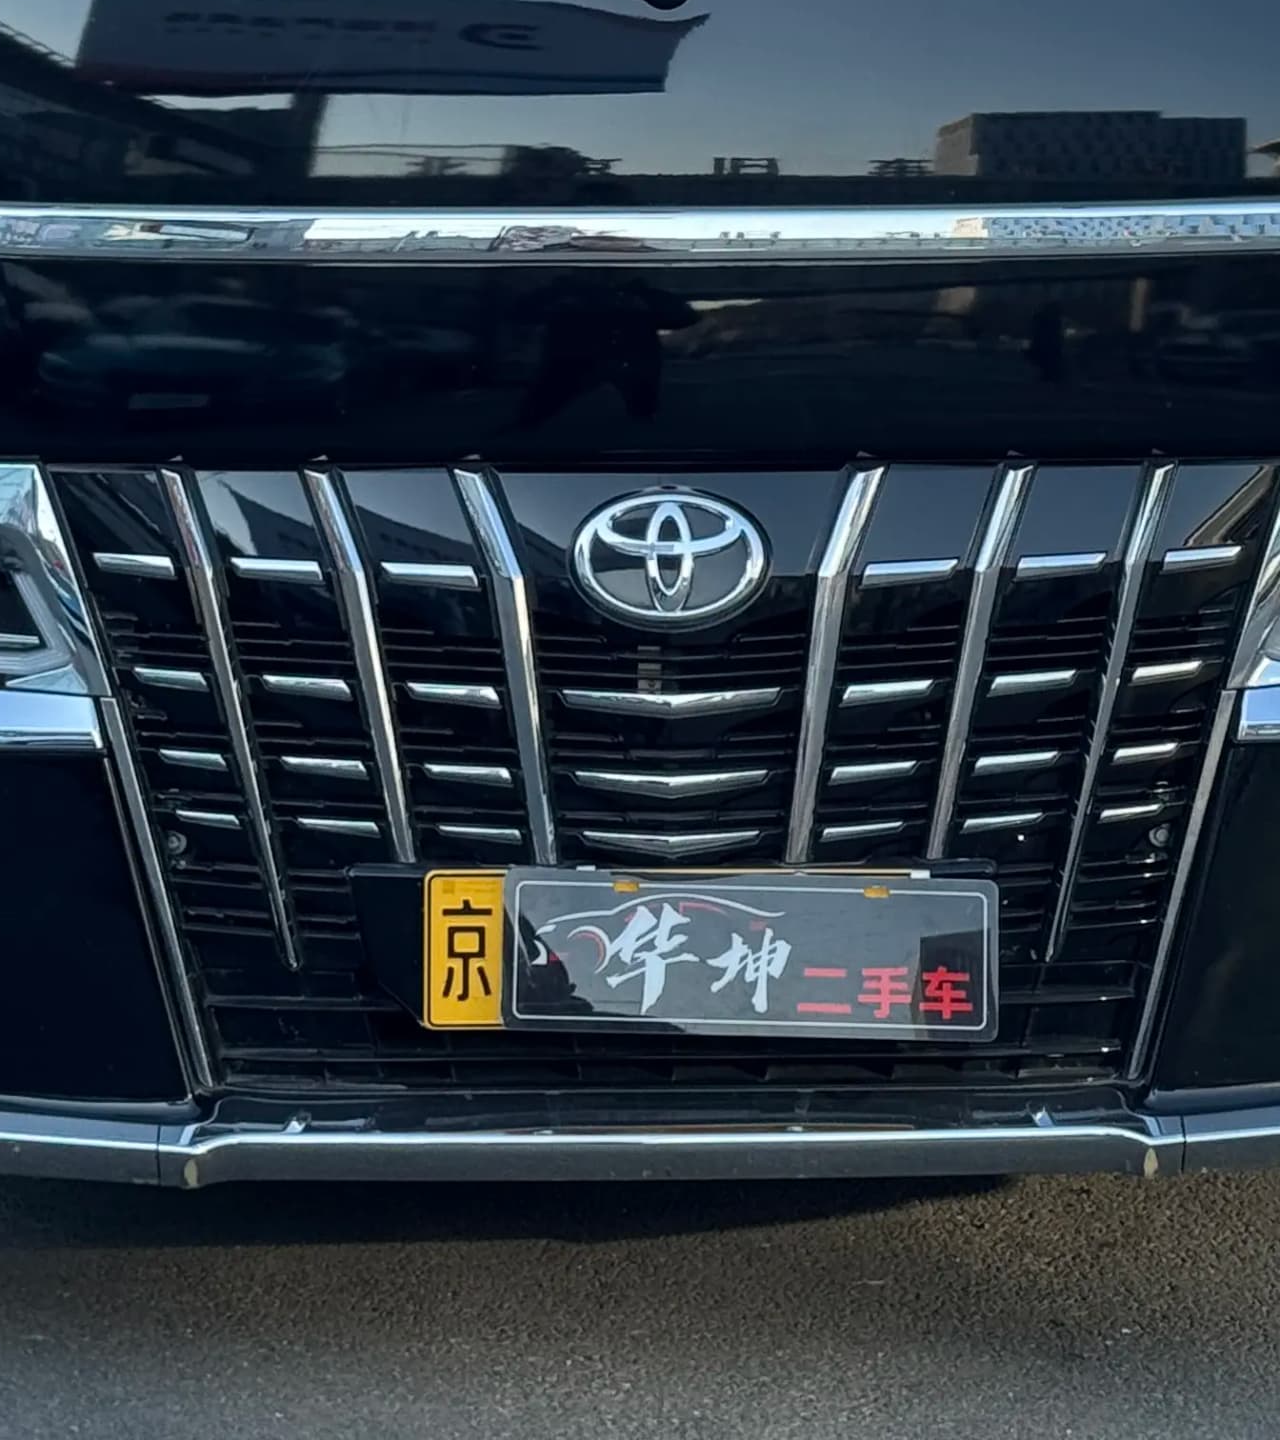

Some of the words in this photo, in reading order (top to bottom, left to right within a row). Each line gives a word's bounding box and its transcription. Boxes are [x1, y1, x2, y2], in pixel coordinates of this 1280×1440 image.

[442, 898, 493, 1001] 京
[796, 966, 974, 1020] 二手车
